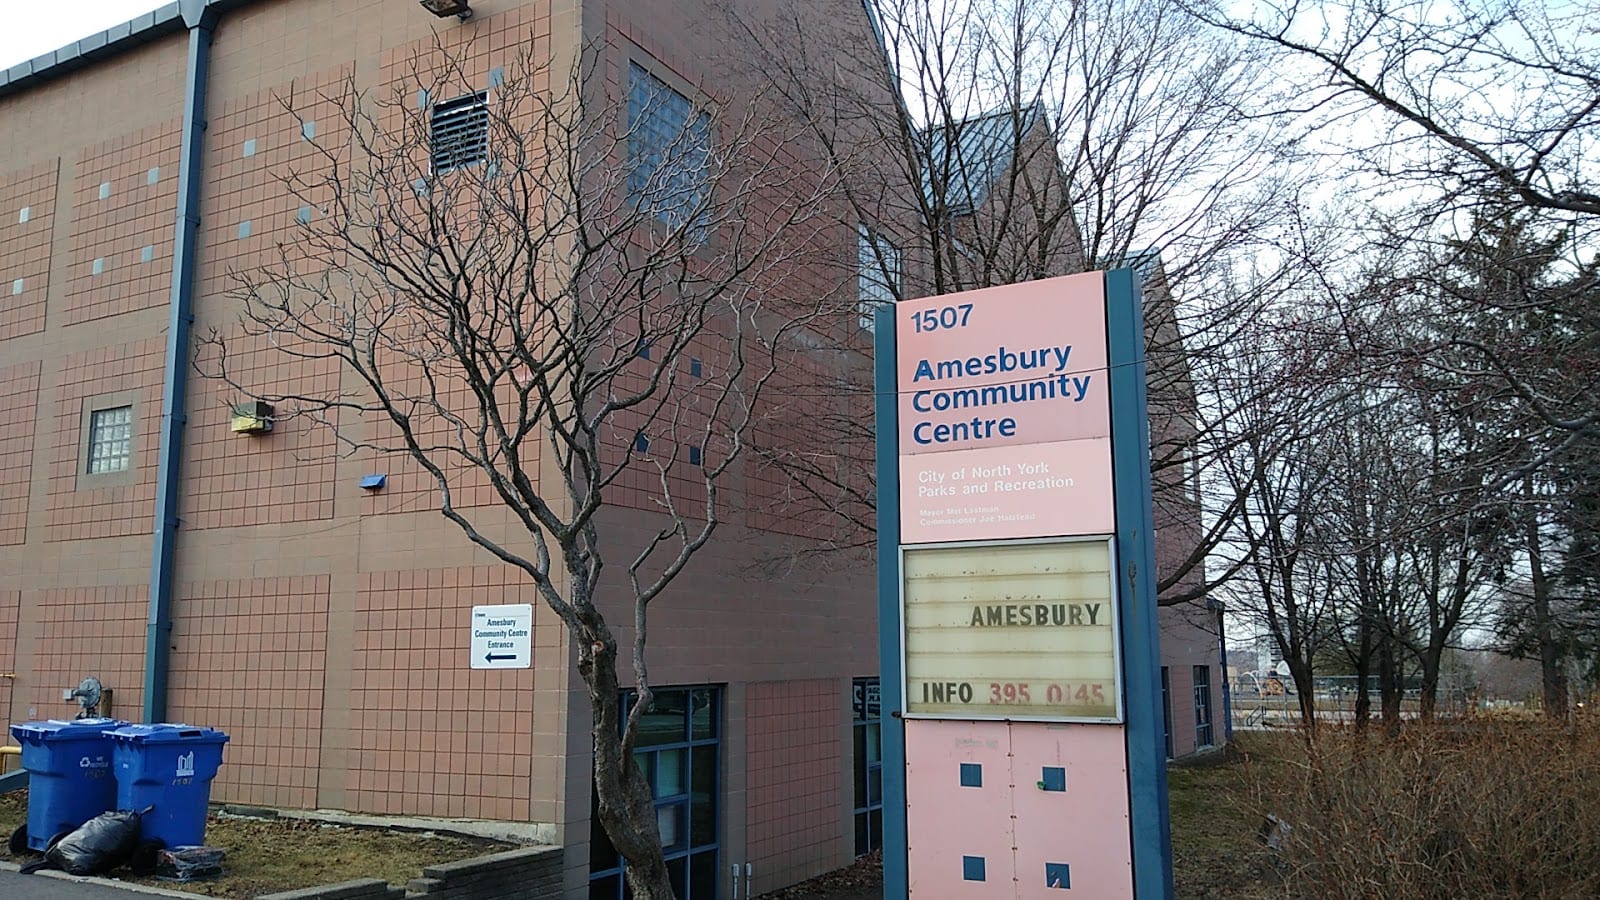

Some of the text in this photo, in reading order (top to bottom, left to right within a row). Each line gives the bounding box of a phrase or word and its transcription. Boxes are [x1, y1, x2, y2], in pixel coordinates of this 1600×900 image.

[911, 303, 974, 333] 1507
[913, 345, 1072, 382] Amesbury
[913, 373, 1090, 412] Community
[913, 417, 1017, 444] Centre
[918, 462, 1049, 484] City of North York
[918, 476, 1074, 497] Parks and Recreation
[487, 618, 516, 627] Amesbury
[971, 603, 1101, 626] AMESBURY
[475, 629, 528, 639] Community Centre
[923, 682, 973, 704] INFO
[989, 682, 1031, 704] 395
